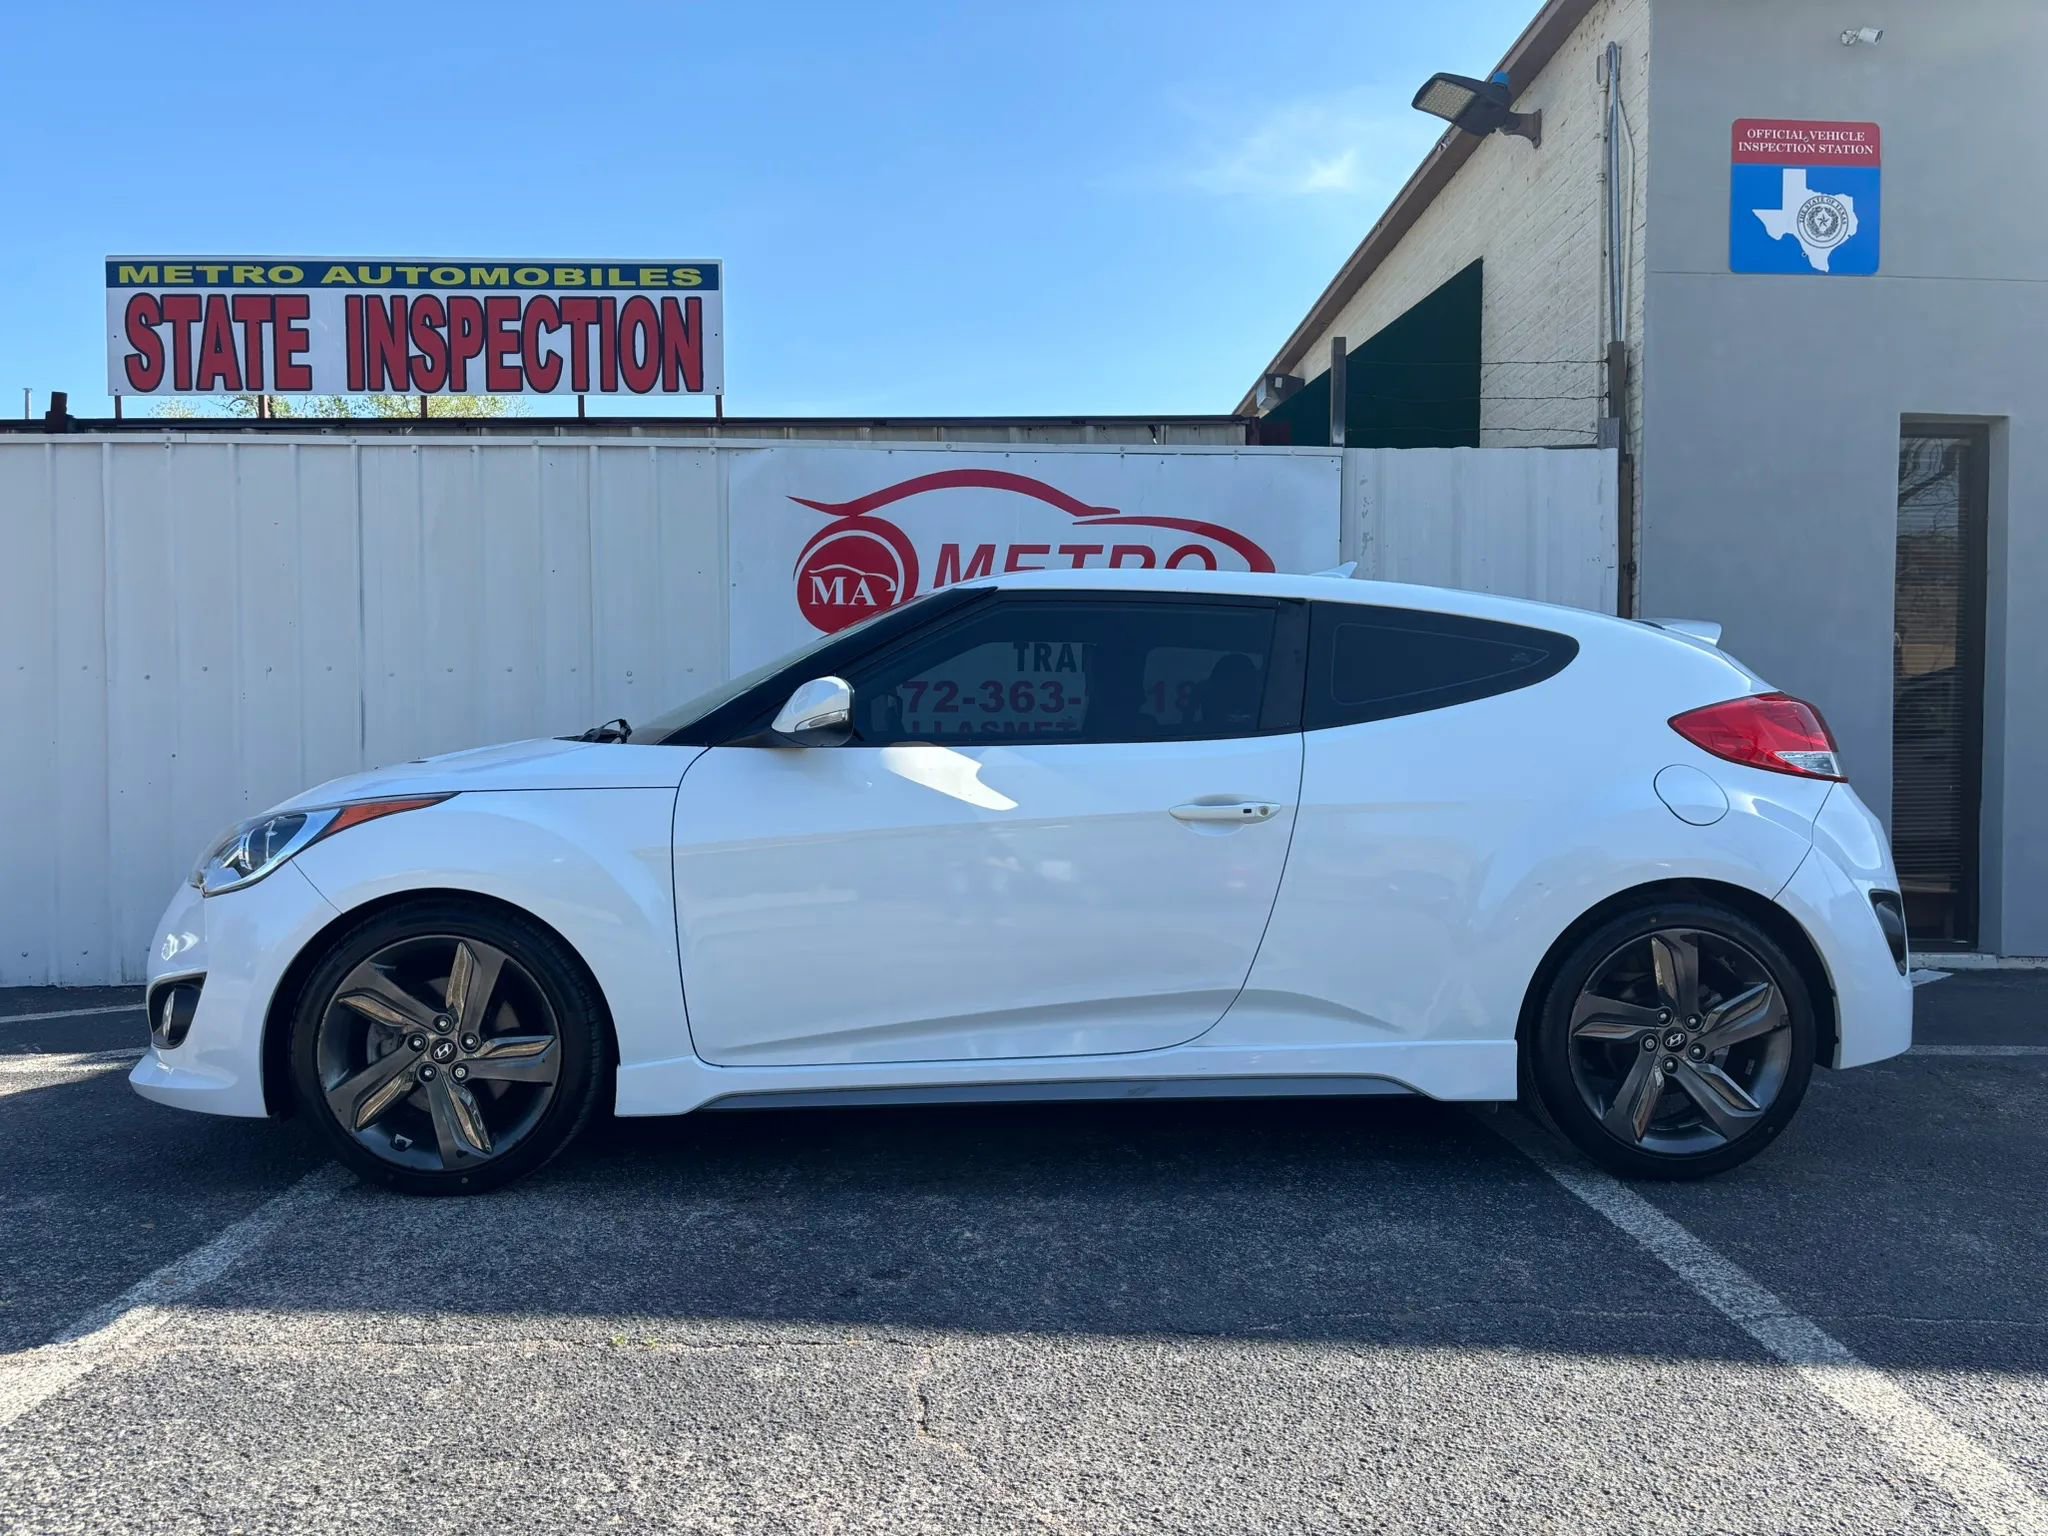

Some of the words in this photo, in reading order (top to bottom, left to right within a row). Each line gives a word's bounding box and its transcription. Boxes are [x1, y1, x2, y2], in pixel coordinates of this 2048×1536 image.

[1747, 129, 1806, 139] OFFICIAL
[1809, 131, 1865, 141] VEHICLE
[1738, 142, 1815, 153] INSPECTION
[1819, 144, 1873, 154] STATION
[118, 265, 304, 284] METRO
[320, 266, 703, 286] AUTOMOBILES
[124, 293, 312, 392] STATE
[345, 295, 704, 393] INSPECTION
[808, 576, 877, 605] MA
[1013, 642, 1086, 673] TRA
